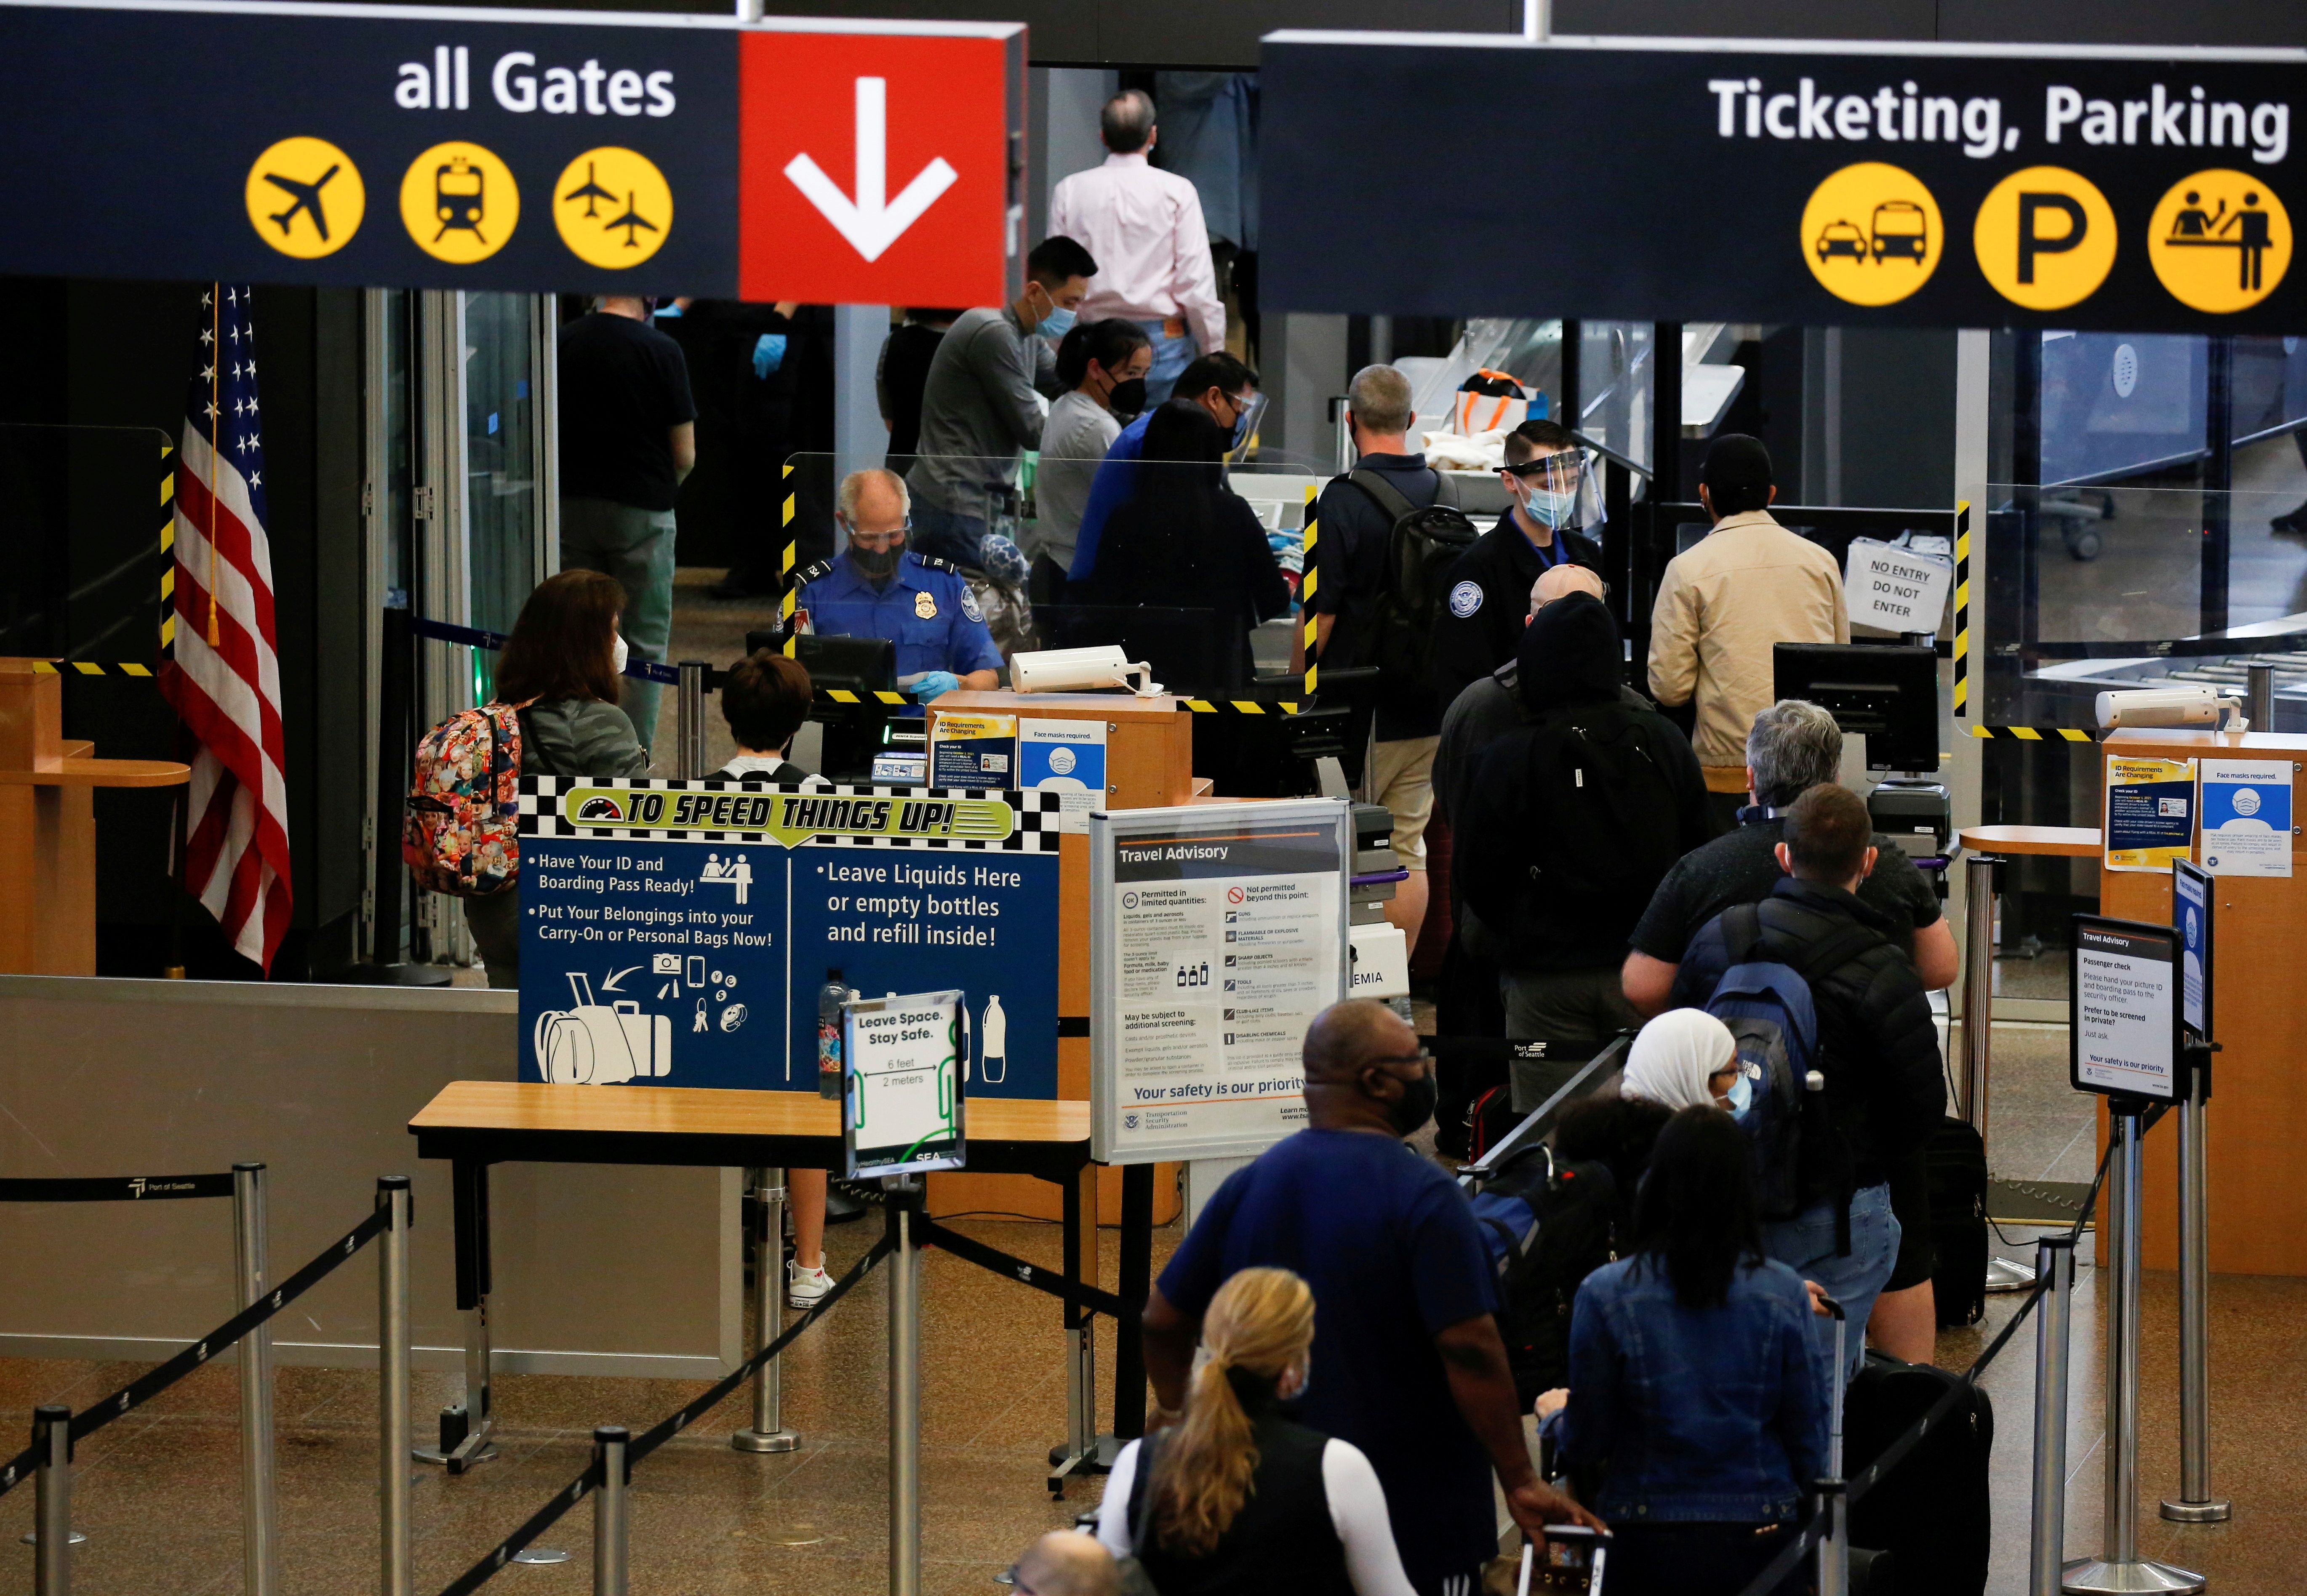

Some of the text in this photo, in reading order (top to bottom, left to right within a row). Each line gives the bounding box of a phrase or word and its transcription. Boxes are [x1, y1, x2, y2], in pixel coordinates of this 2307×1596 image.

[395, 45, 675, 117] all Gates
[1708, 77, 2289, 163] Ticketing, Parking
[807, 565, 820, 577] TSA
[1871, 560, 1931, 582] NO ENTRY
[1873, 581, 1920, 599] DO NOT
[1874, 600, 1910, 616] ENTER
[627, 793, 955, 834] TO SPEED THINGS UP!
[1120, 845, 1228, 862] Travel Advisory
[540, 854, 663, 871] Have Your ID and
[829, 862, 1021, 889] Leave Liquids Here
[539, 875, 693, 896] Boarding Pass Ready!
[1261, 884, 1295, 893] permitted
[1247, 893, 1272, 902] beyond
[828, 894, 999, 919] or empty bottles
[539, 905, 753, 927] Put Your Belongings into your
[539, 926, 771, 948] Carry-On or Personal Bags Now!
[828, 922, 994, 946] and refill inside!
[2083, 933, 2129, 947] Travel Advisory
[2084, 957, 2112, 968] Passenger
[2084, 973, 2102, 981] Please
[2104, 975, 2118, 983] hand
[2096, 983, 2121, 994] boarding
[2084, 991, 2128, 1003] security officer.
[859, 1012, 943, 1028] Leave Space.
[2084, 1005, 2102, 1014] Prefer
[2120, 1012, 2145, 1021] screened
[2091, 1016, 2115, 1025] private?
[1125, 1020, 1160, 1029] additional
[869, 1028, 933, 1044] Stay Safe.
[888, 1058, 914, 1069] 6 feet
[2104, 1058, 2122, 1066] safety
[2142, 1063, 2163, 1073] priority
[883, 1075, 923, 1087] 2 meters
[1134, 1088, 1166, 1099] Your
[1170, 1084, 1212, 1097] safety
[1216, 1082, 1227, 1094] is
[1231, 1083, 1254, 1093] our
